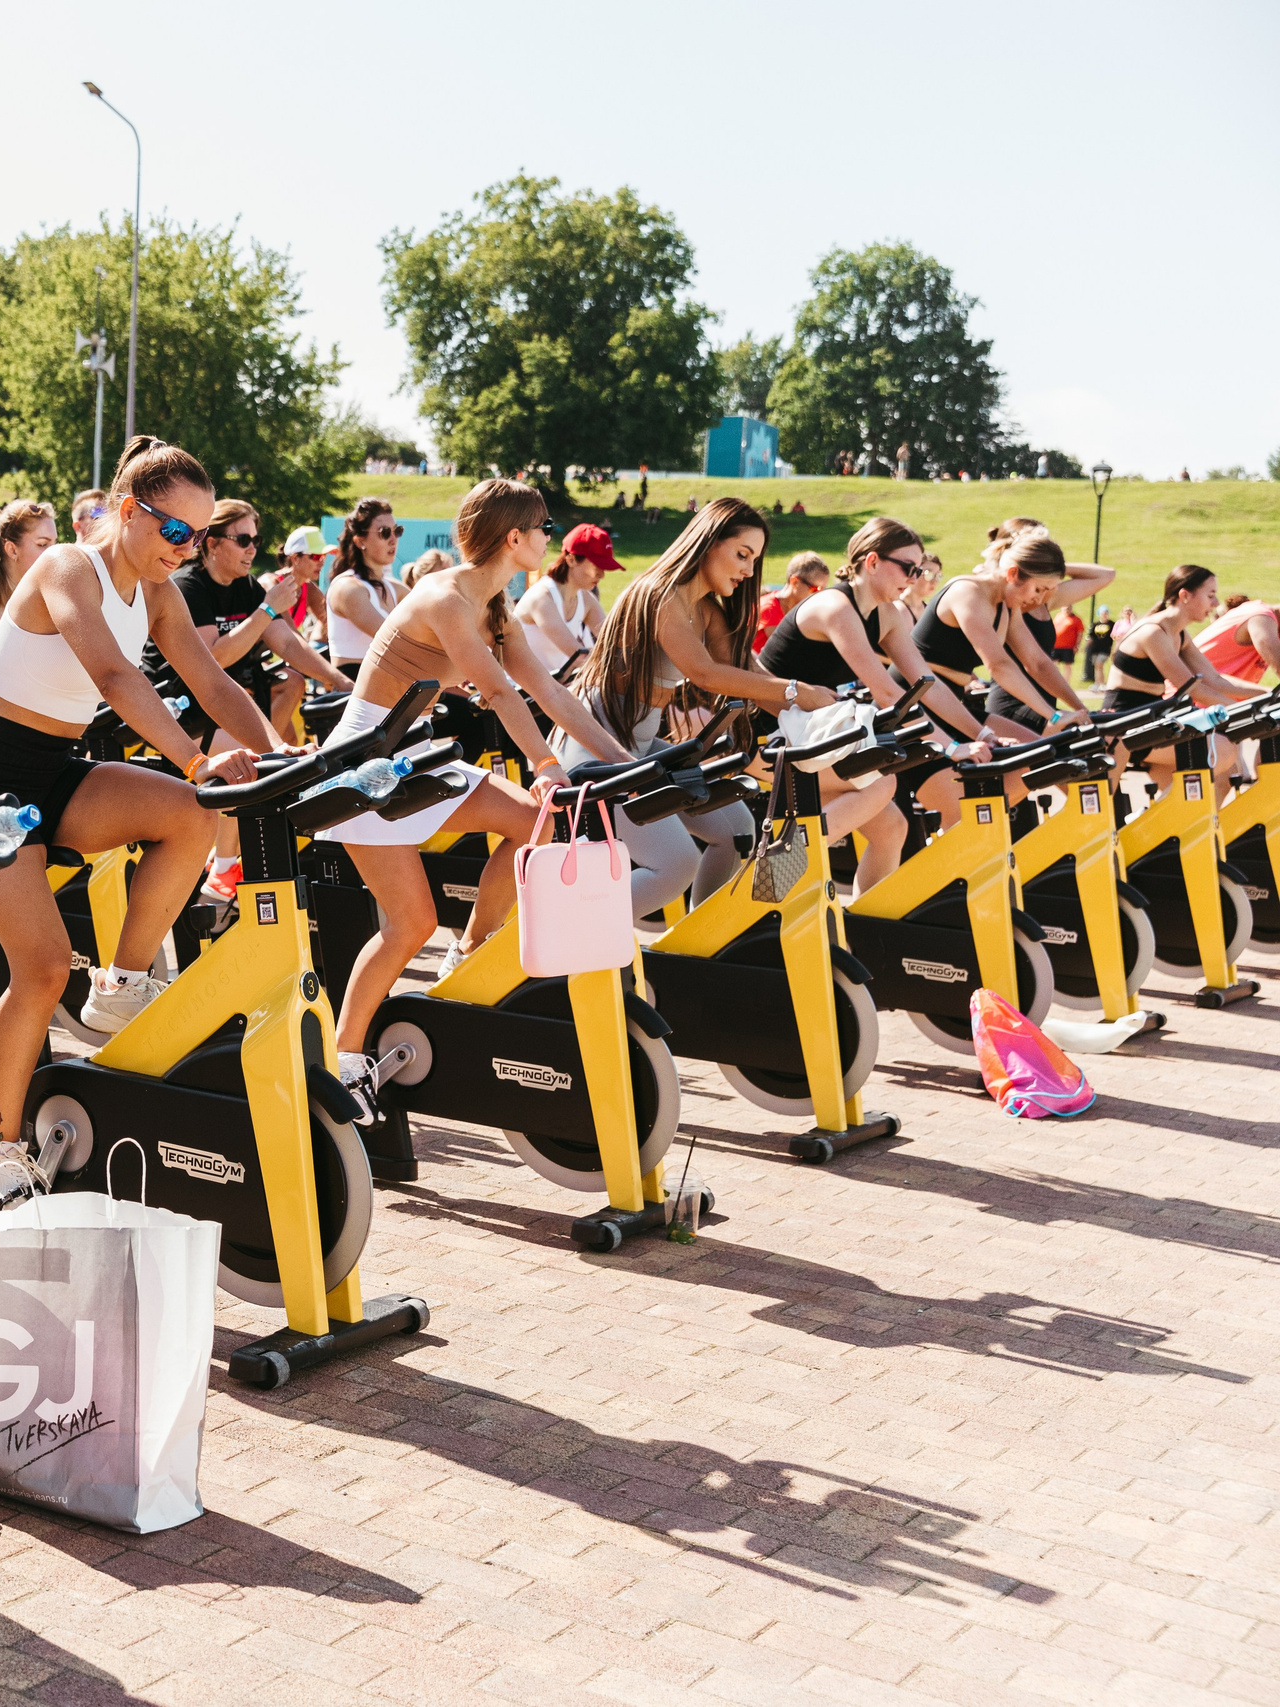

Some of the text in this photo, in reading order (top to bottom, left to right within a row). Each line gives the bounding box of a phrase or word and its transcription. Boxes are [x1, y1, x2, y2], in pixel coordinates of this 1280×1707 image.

[903, 960, 966, 980] TECHNOGYM
[307, 979, 315, 995] 3
[494, 1060, 569, 1086] TECHNOGYM
[160, 1145, 241, 1178] TECHNOGYM
